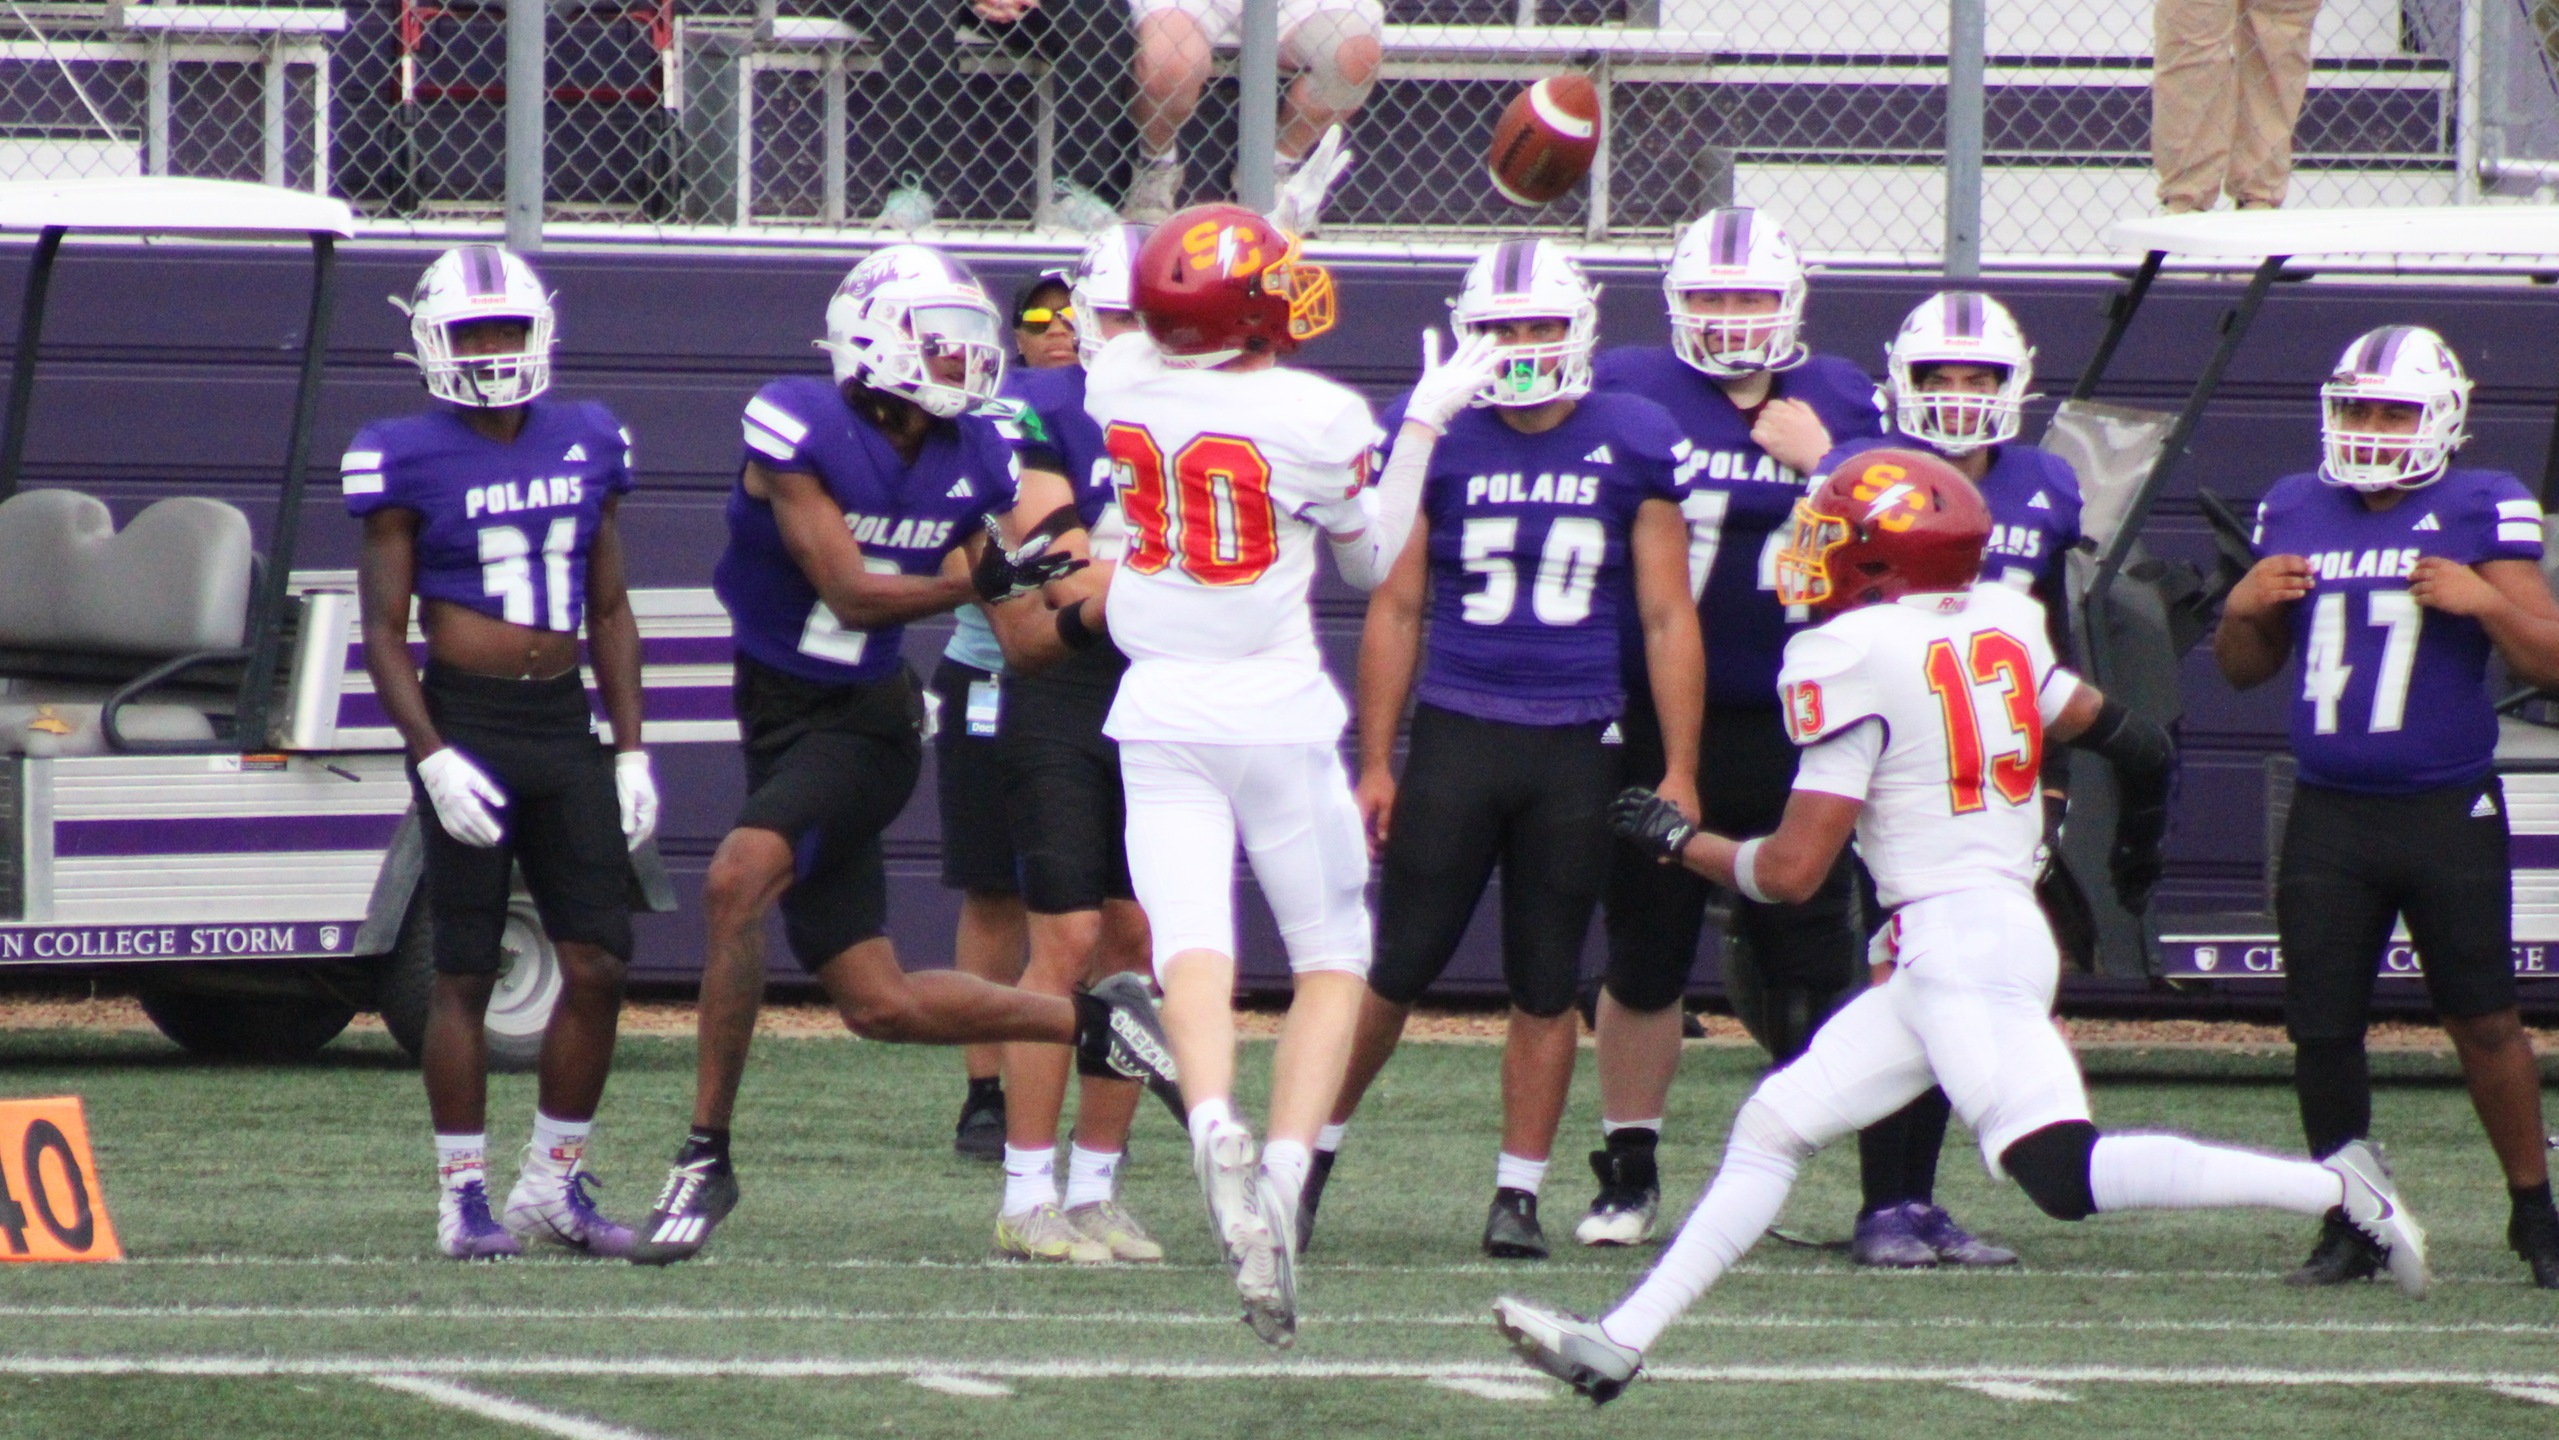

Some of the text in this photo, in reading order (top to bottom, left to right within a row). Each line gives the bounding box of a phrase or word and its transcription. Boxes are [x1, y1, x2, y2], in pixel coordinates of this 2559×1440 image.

[466, 476, 583, 518] POLARS
[1104, 419, 1280, 588] 30
[1466, 474, 1600, 506] POLARS
[1686, 450, 1808, 485] POLAR
[477, 516, 578, 632] 31
[1461, 516, 1606, 626] 50
[2303, 589, 2424, 735] 47
[1784, 679, 1824, 739] 13
[1926, 628, 2044, 816] 13
[33, 929, 176, 958] COLLEGE
[190, 927, 295, 954] STORM
